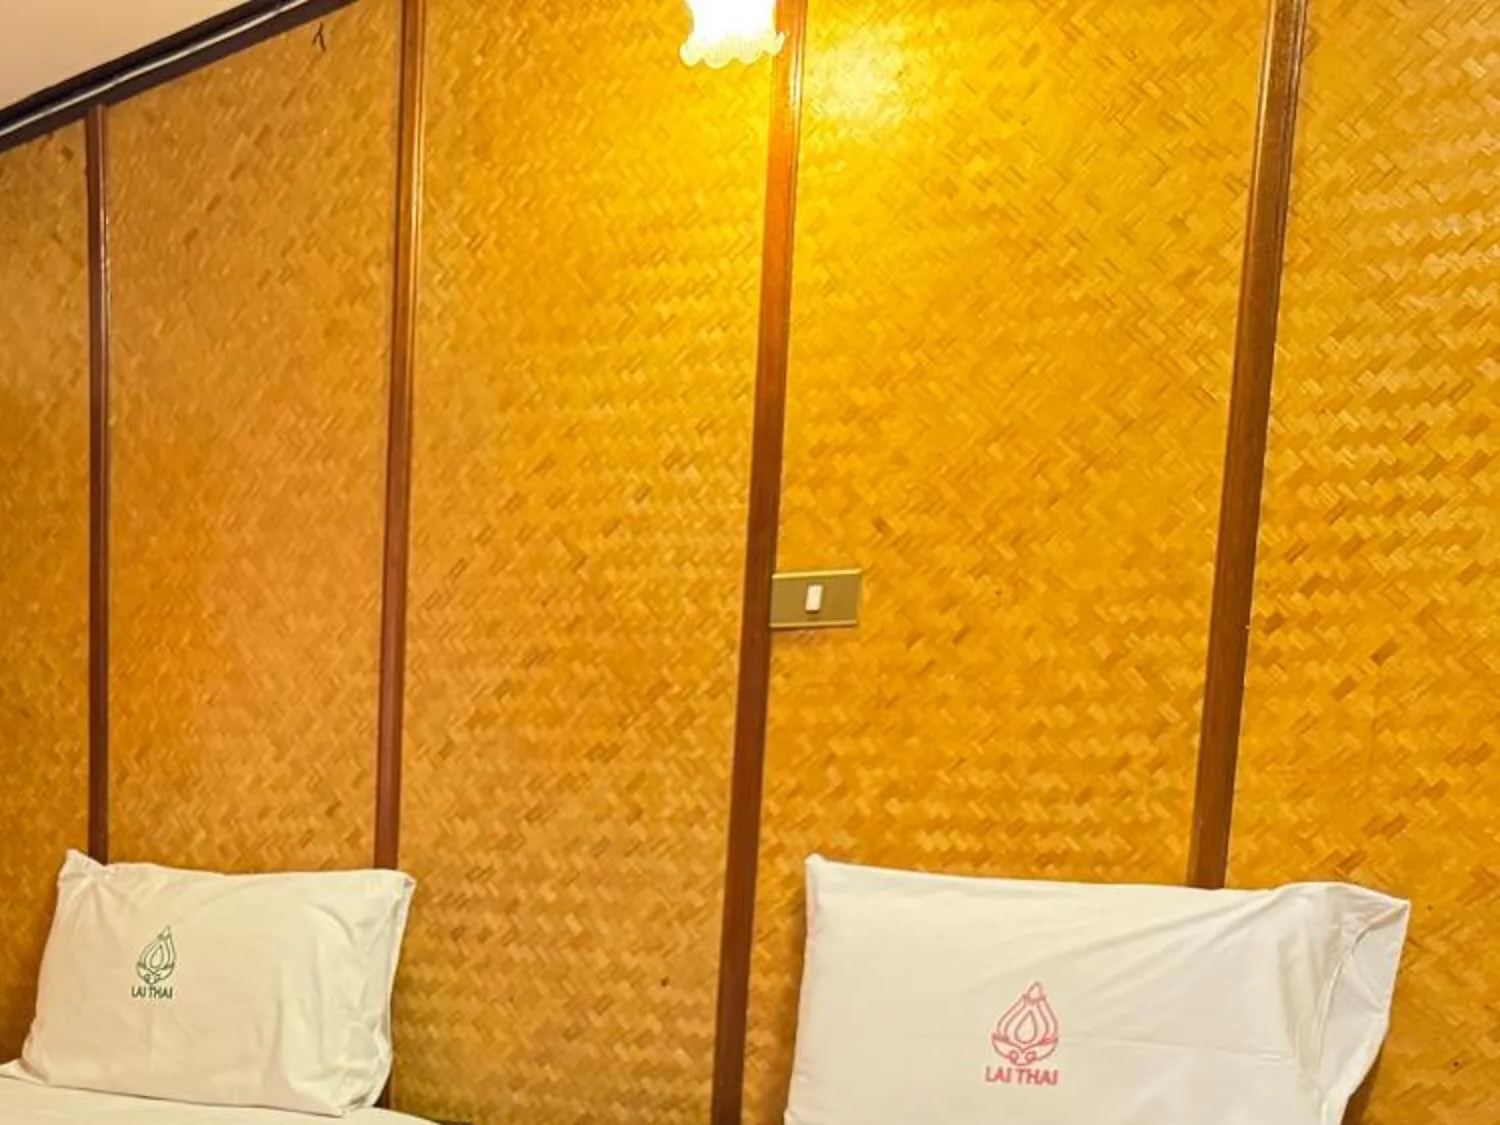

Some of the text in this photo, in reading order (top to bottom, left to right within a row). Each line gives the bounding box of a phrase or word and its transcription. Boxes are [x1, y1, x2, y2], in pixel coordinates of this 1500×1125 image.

[131, 986, 173, 999] LAI THAI
[985, 1066, 1058, 1086] LAI THAI
